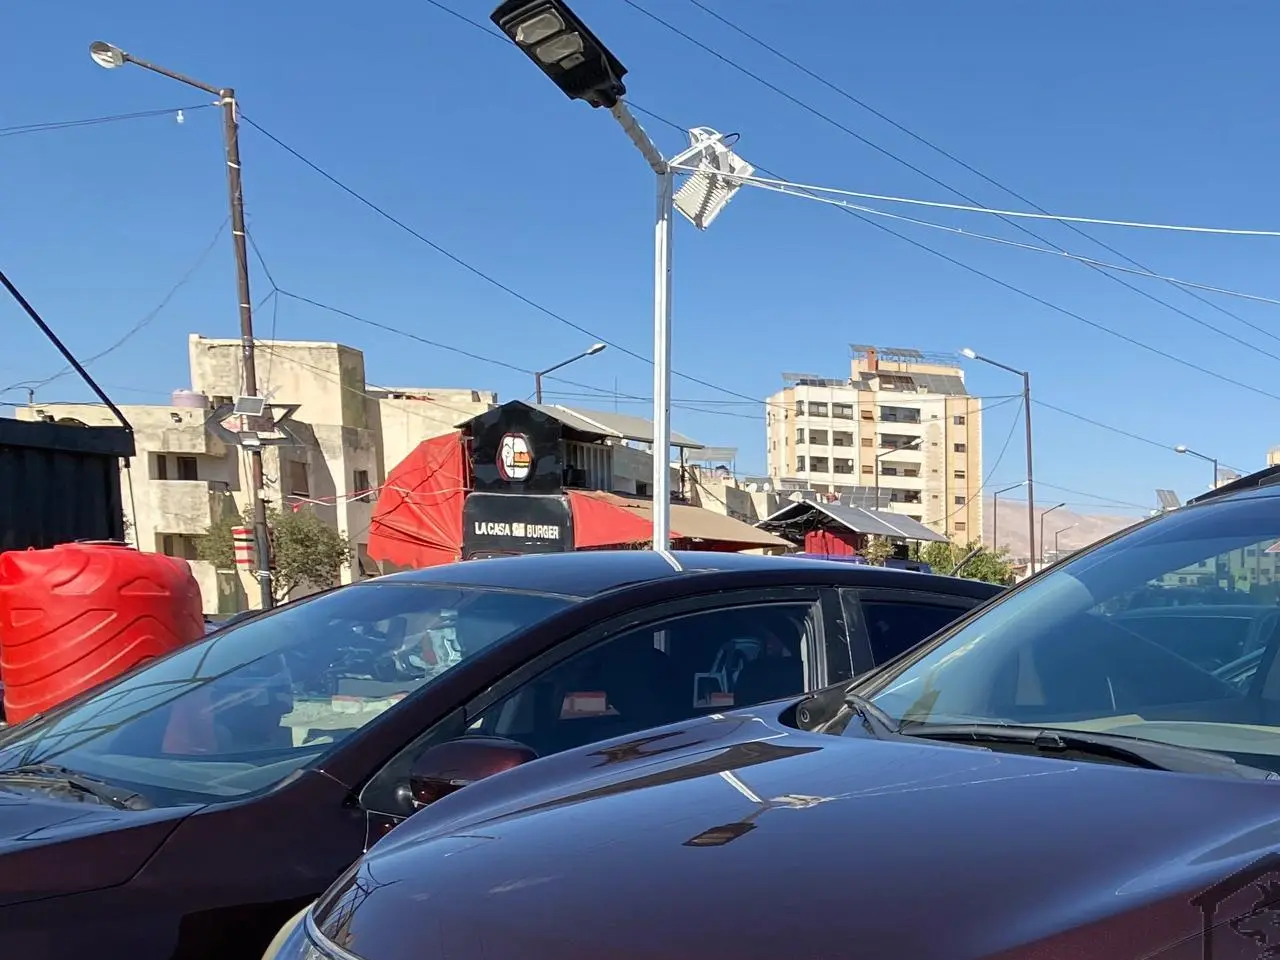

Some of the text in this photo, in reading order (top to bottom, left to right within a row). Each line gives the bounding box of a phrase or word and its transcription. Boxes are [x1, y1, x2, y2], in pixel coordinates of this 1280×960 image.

[474, 522, 559, 539] LA CASA BURGER
